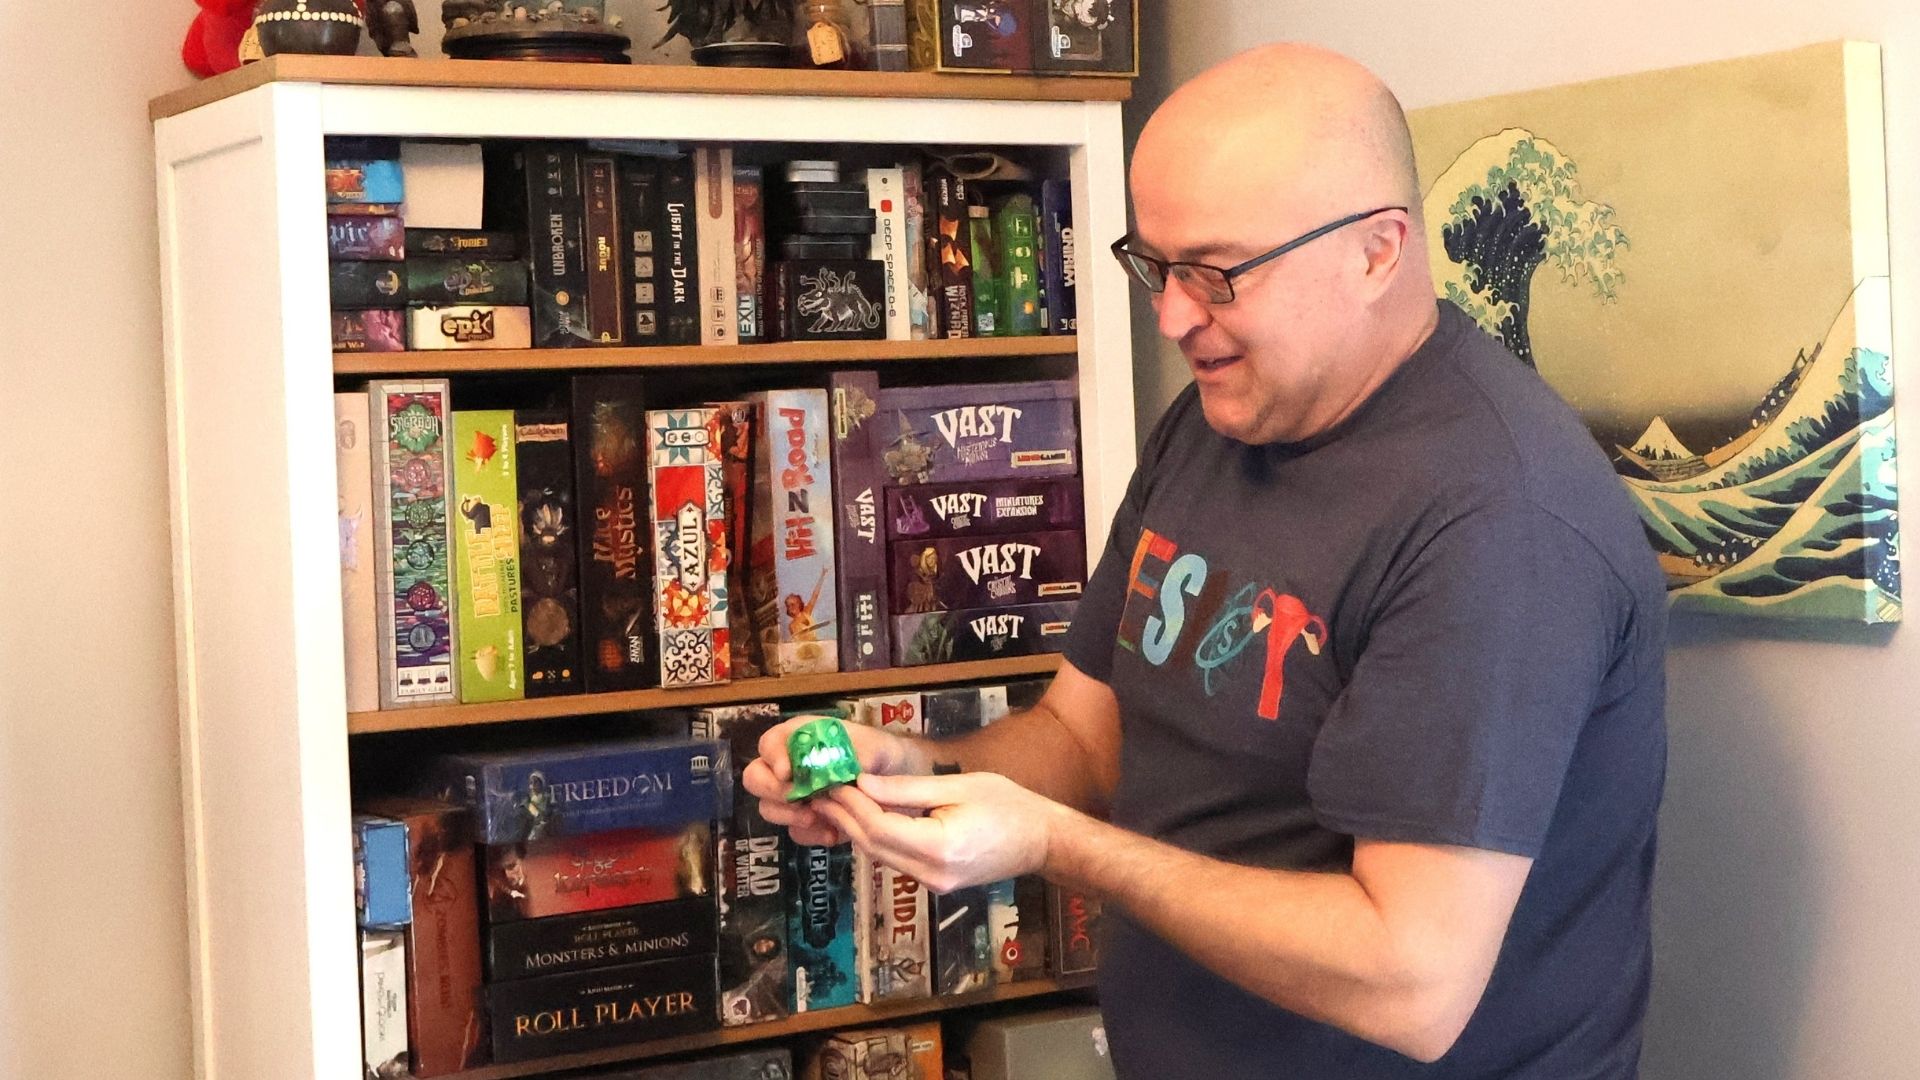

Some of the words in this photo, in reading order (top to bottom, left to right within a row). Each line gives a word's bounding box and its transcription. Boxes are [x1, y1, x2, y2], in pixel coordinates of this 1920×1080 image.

[667, 202, 685, 240] LIGHT
[551, 214, 567, 276] UNBROKEN
[673, 240, 681, 250] IN
[673, 251, 682, 266] THE
[670, 267, 686, 303] DARK
[885, 254, 896, 294] SPACE
[738, 295, 755, 334] EXIT
[945, 285, 961, 339] WIZARD
[958, 285, 968, 308] ROCK
[960, 308, 969, 338] PAPER
[931, 404, 1022, 449] VAST
[777, 408, 815, 489] Road
[788, 488, 809, 513] Z
[855, 487, 876, 544] VAST
[930, 492, 988, 521] VAST
[995, 494, 1044, 509] MINIATURES
[996, 506, 1038, 518] EXPANSION
[684, 517, 701, 577] AZUL
[955, 542, 1041, 585] VAST
[464, 528, 501, 618] BATTLE
[506, 559, 519, 613] PASTURES
[970, 614, 1024, 643] VAST
[549, 774, 673, 804] FREEDOM
[735, 838, 748, 853] OF
[735, 854, 750, 898] WINTER
[749, 835, 780, 896] DEAD
[893, 875, 919, 944] RIDE
[525, 944, 608, 969] MONSTERS
[608, 943, 619, 956] &
[625, 932, 690, 954] MINIONS
[515, 1006, 585, 1037] ROLL
[593, 991, 697, 1025] PLAYER
